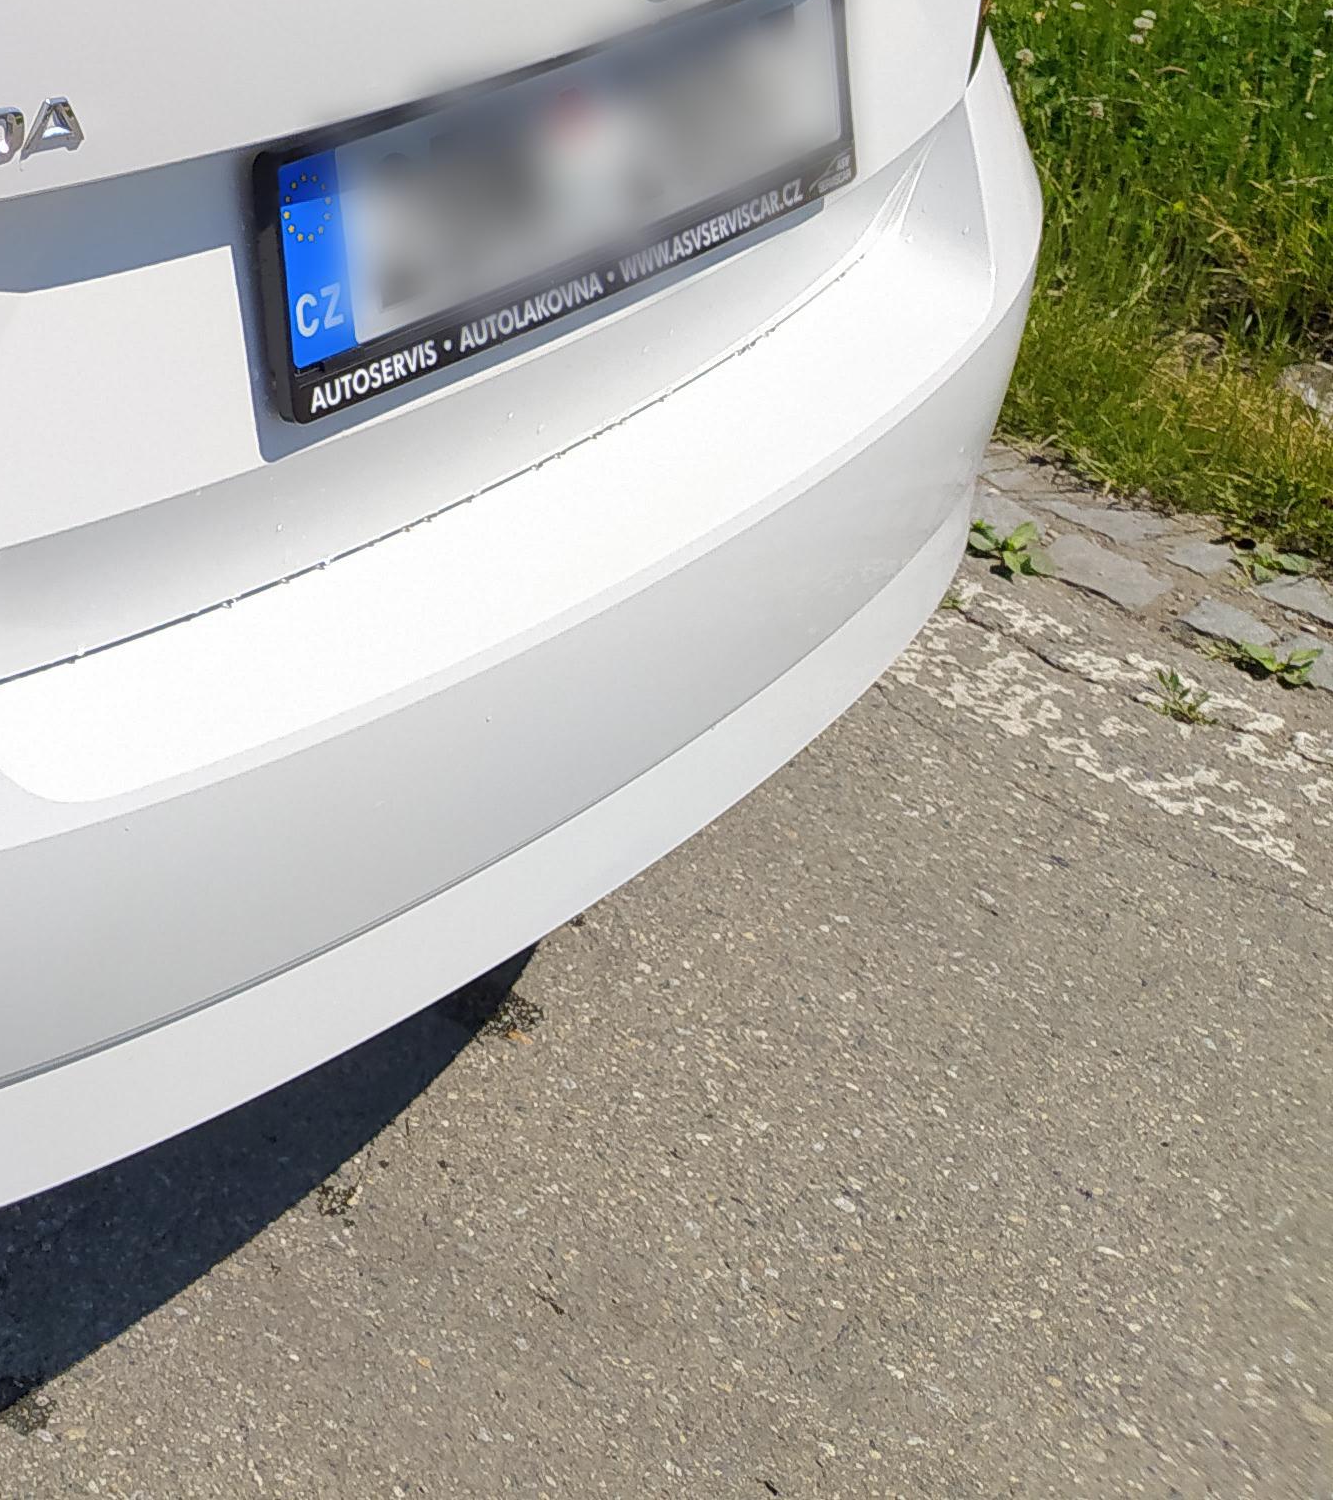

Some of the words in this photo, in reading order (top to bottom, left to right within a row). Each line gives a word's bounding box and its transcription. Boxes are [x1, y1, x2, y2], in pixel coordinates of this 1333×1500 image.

[295, 282, 345, 338] CZ
[310, 339, 438, 414] AUTOSERVIS
[459, 272, 604, 353] AUTOLAKOVNA
[618, 178, 803, 283] WWW.ASVSERVISCAR.CZ
